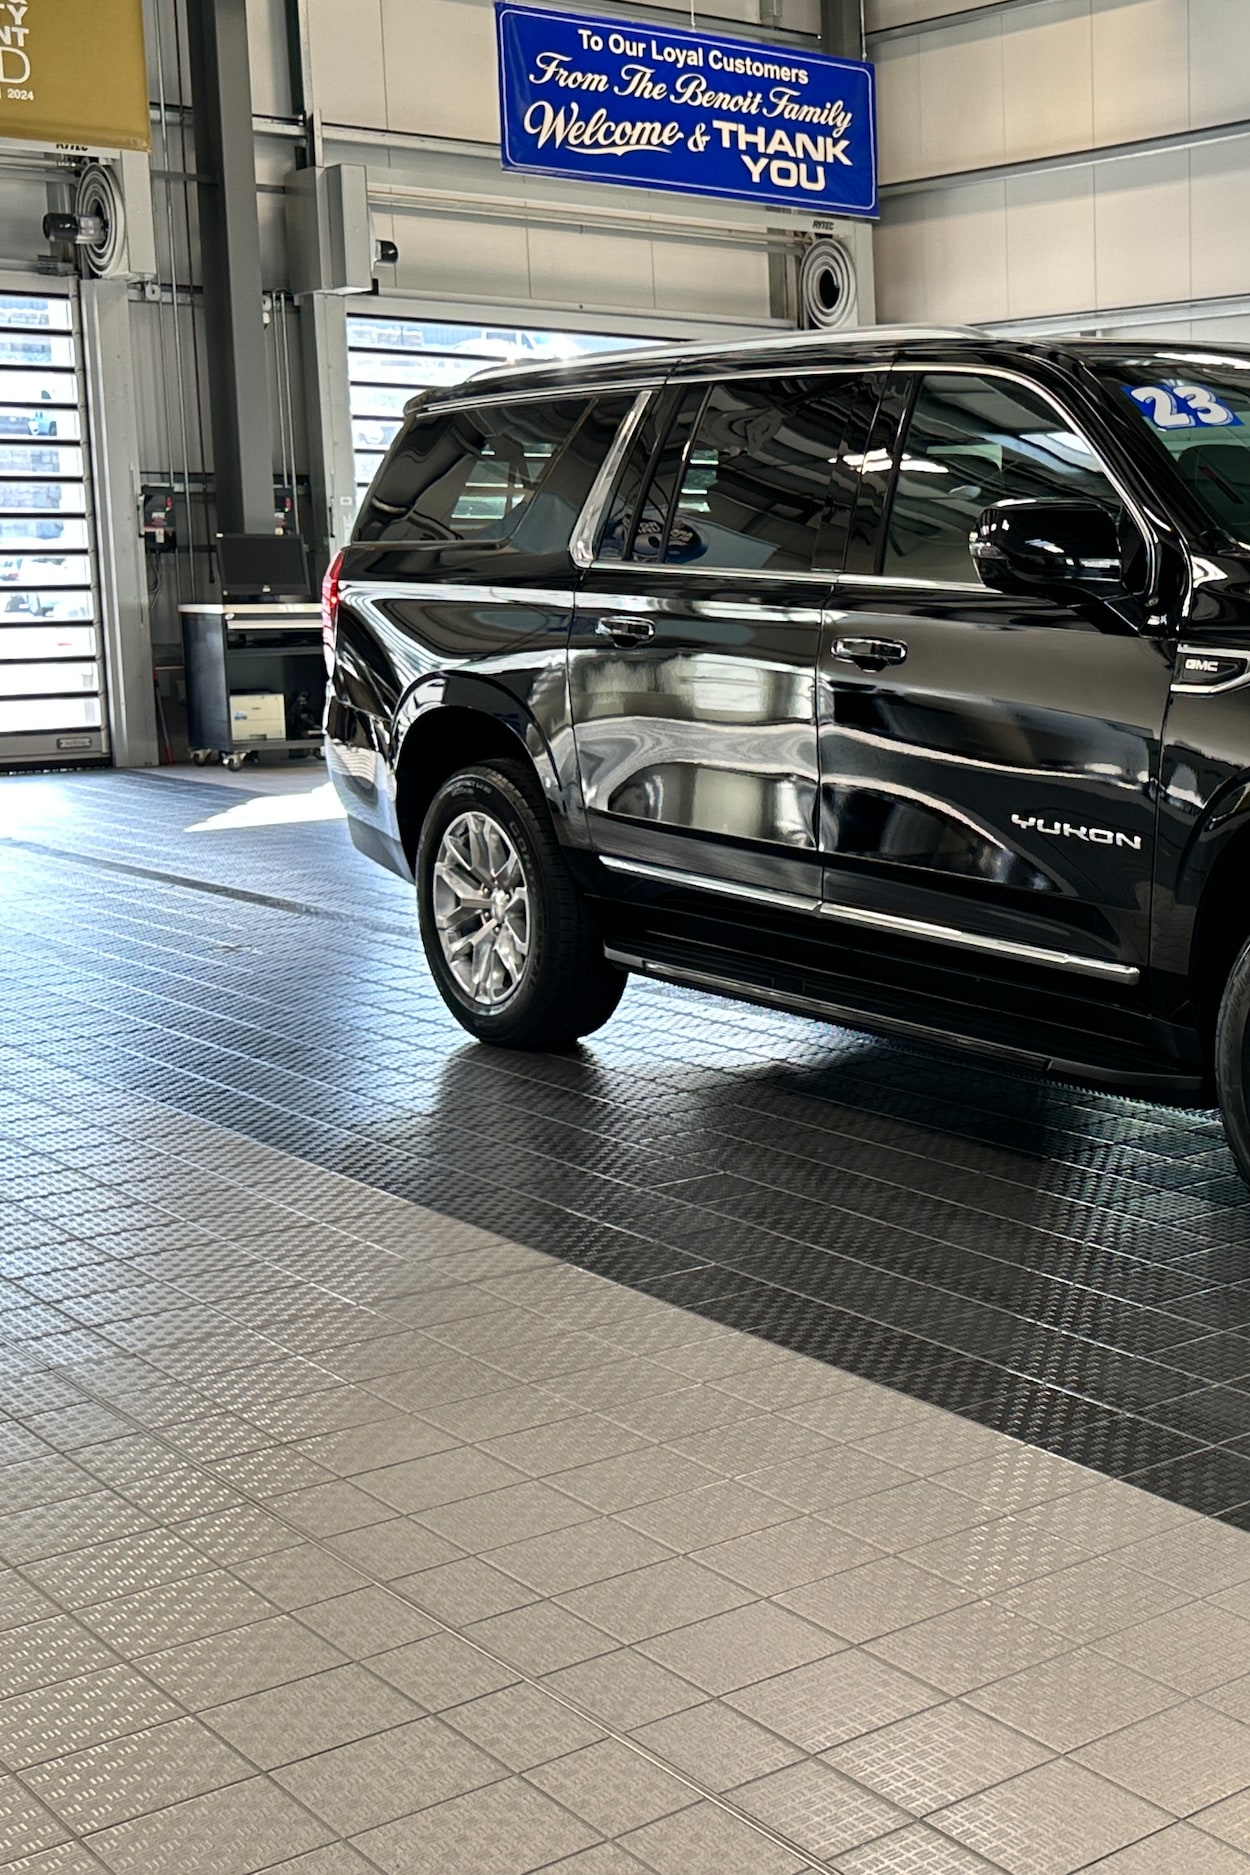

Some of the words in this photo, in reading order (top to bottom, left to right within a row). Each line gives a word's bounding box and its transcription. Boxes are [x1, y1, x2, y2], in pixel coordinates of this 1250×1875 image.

[578, 29, 603, 51] To
[608, 33, 645, 56] Our
[651, 39, 703, 68] Loyal
[708, 50, 808, 85] Customers
[7, 88, 34, 101] 2024
[529, 52, 609, 92] From
[614, 63, 667, 101] The
[669, 73, 763, 115] Benoit
[763, 86, 852, 138] Family
[523, 101, 684, 152] Welcome
[687, 123, 710, 153] &
[712, 119, 853, 167] THANK
[741, 154, 826, 192] YOU
[1131, 386, 1233, 427] 23
[1185, 659, 1218, 672] GMC
[1011, 813, 1142, 850] YUKON
